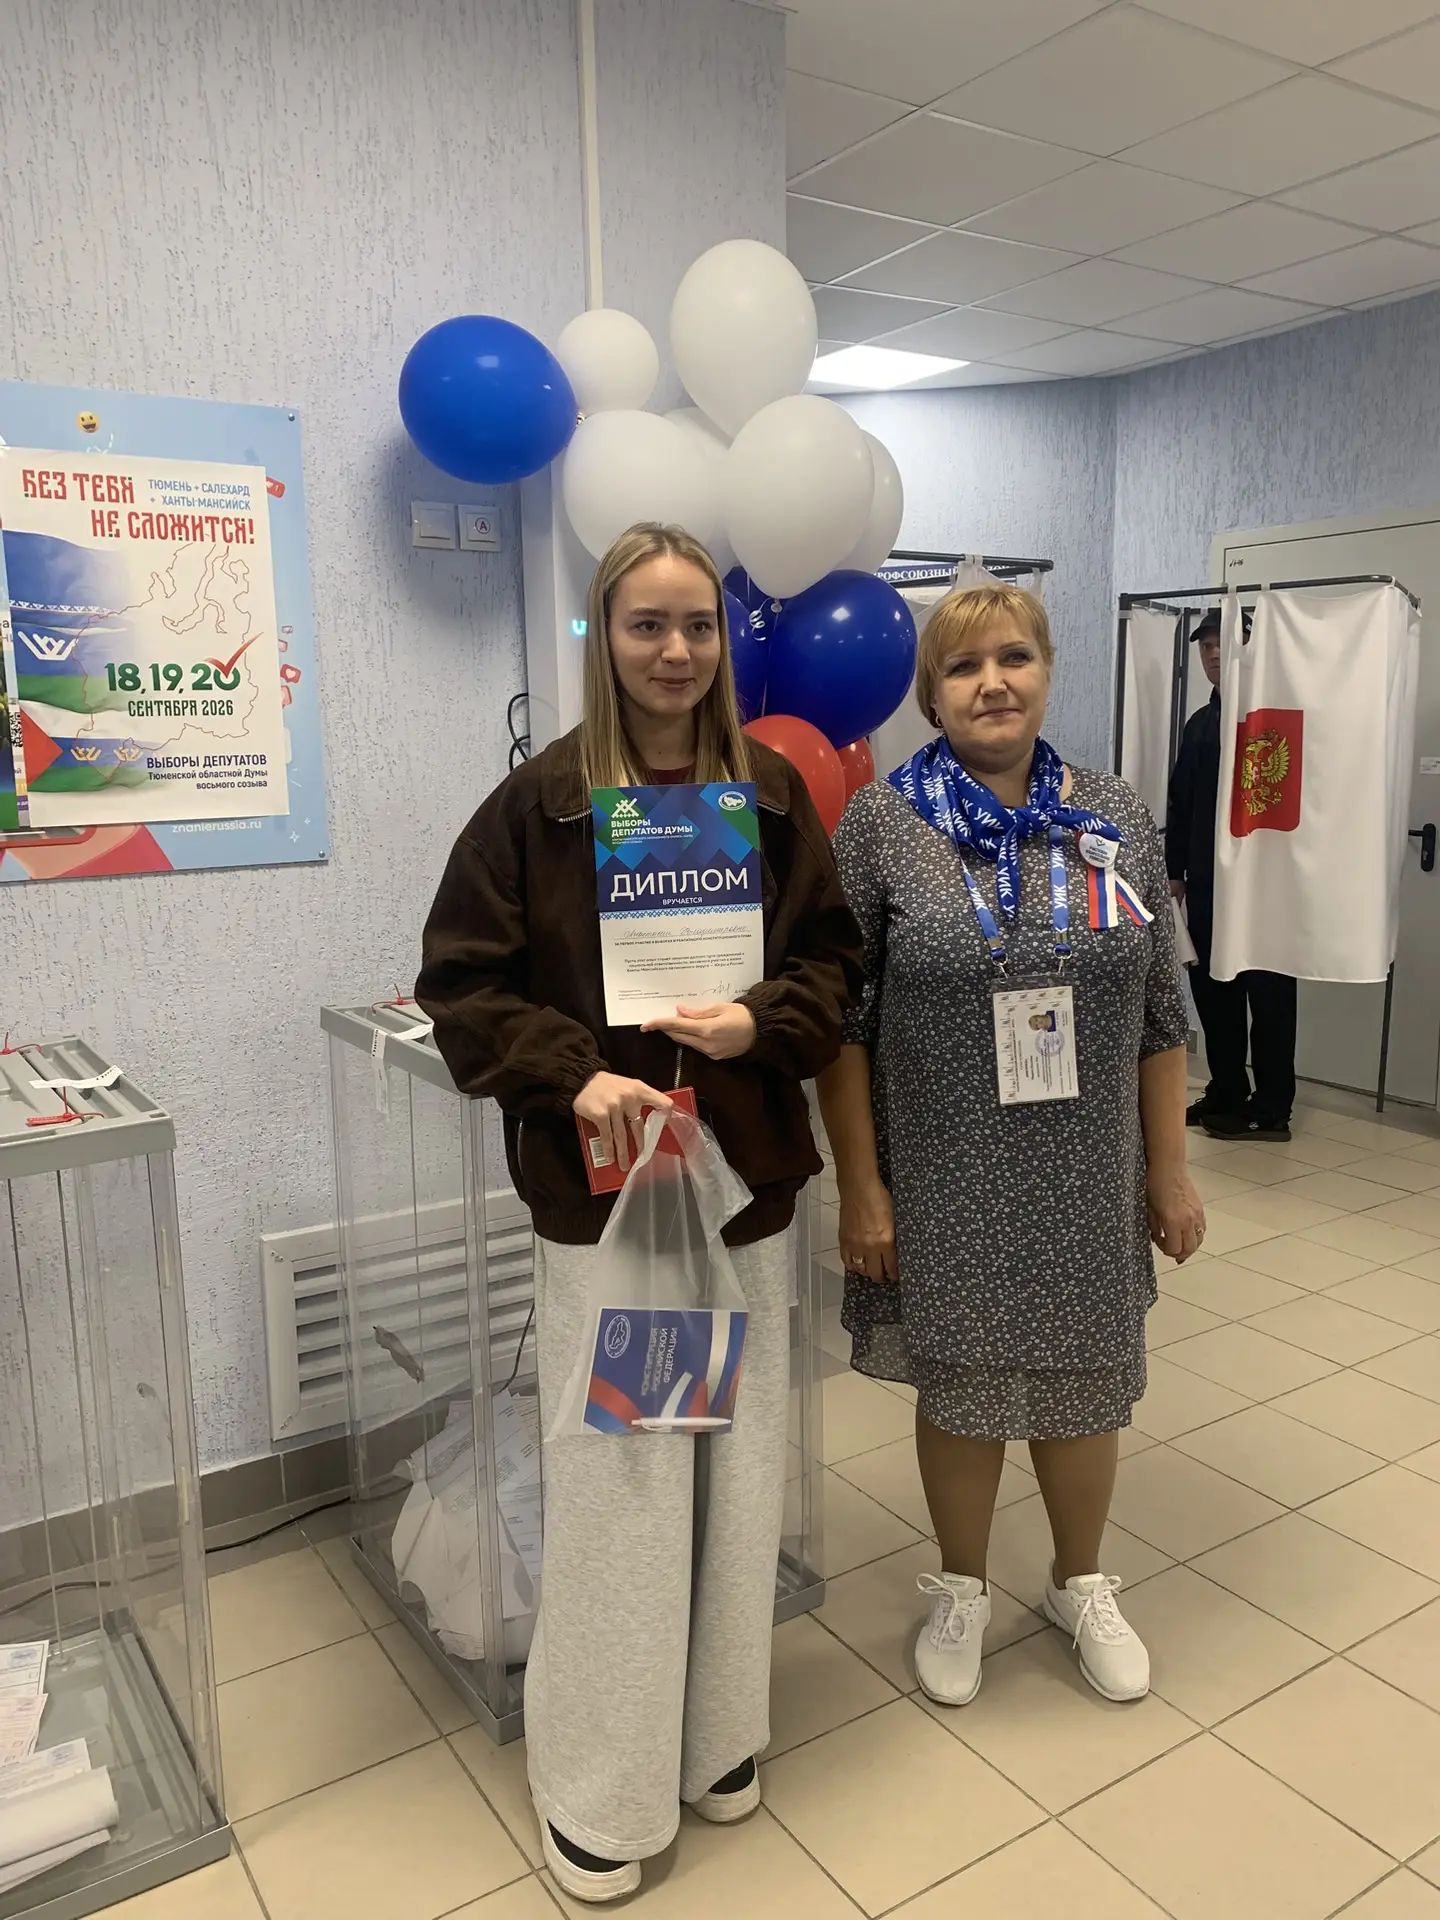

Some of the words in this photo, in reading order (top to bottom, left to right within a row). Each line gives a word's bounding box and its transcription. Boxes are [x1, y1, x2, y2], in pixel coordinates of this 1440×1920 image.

[22, 469, 67, 500] БЕЗ
[72, 473, 135, 504] ТЕБЯ
[148, 479, 192, 492] ТЮМЕНЬ
[202, 483, 251, 497] САЛЕХАРД
[91, 509, 121, 538] НЕ
[128, 511, 255, 545] СЛОЖИТСЯ!
[873, 566, 959, 580] РОФСОЮЗНЫЙ
[128, 700, 198, 717] СЕНТЯБРЯ
[202, 700, 234, 716] 2026
[147, 756, 200, 769] ВЫБОРЫ
[202, 754, 267, 768] ДЕПУТАТОВ
[148, 770, 197, 781] Тюменской
[198, 769, 242, 779] областной
[244, 769, 268, 779] Думы
[196, 780, 236, 789] восьмого
[237, 780, 268, 788] созыва
[901, 772, 916, 800] УИК
[921, 777, 936, 801] УИК
[172, 820, 262, 833] znanierussia.ru
[611, 818, 651, 828] ВЫБОРЫ
[611, 827, 663, 837] ДЕПУТАТОВ
[664, 825, 693, 835] ДУМЫ
[1051, 844, 1065, 868] УИК
[610, 867, 748, 903] ДИПЛОМ
[997, 866, 1014, 899] УИК
[662, 897, 703, 906] ВРУЧАЕТСЯ
[968, 886, 989, 911] УИК
[1053, 884, 1068, 909] УИК
[663, 1327, 678, 1384] ФЕДЕРАЦИИ
